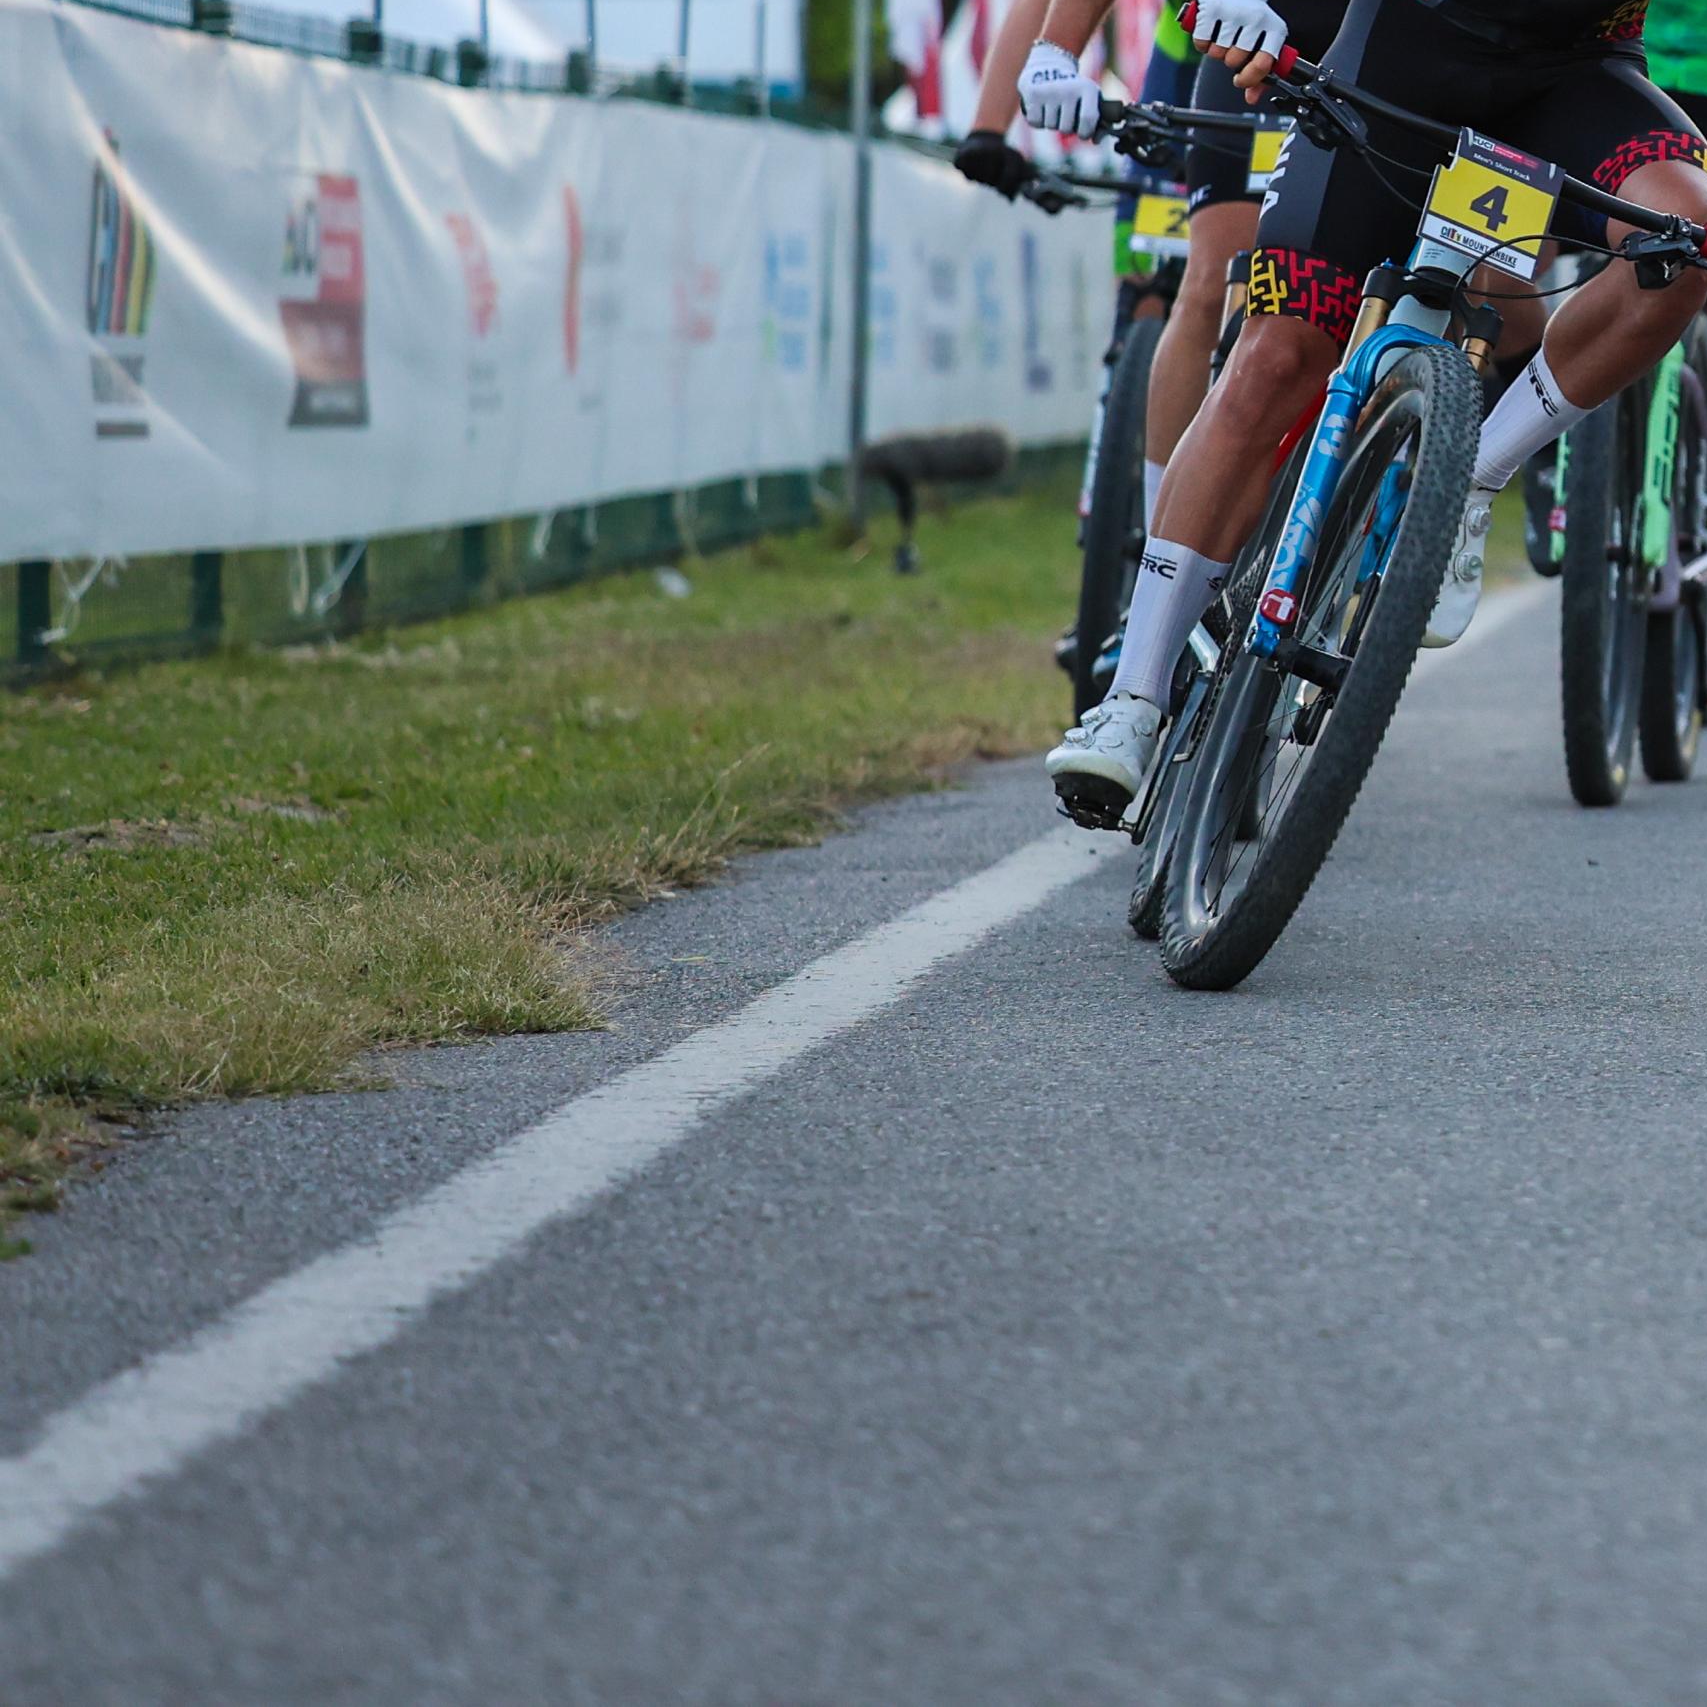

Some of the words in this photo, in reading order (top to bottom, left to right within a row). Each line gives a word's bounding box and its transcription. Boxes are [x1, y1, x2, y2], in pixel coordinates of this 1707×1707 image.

[1470, 185, 1509, 232] 4
[1440, 226, 1461, 242] CITY
[1141, 557, 1178, 581] RC
